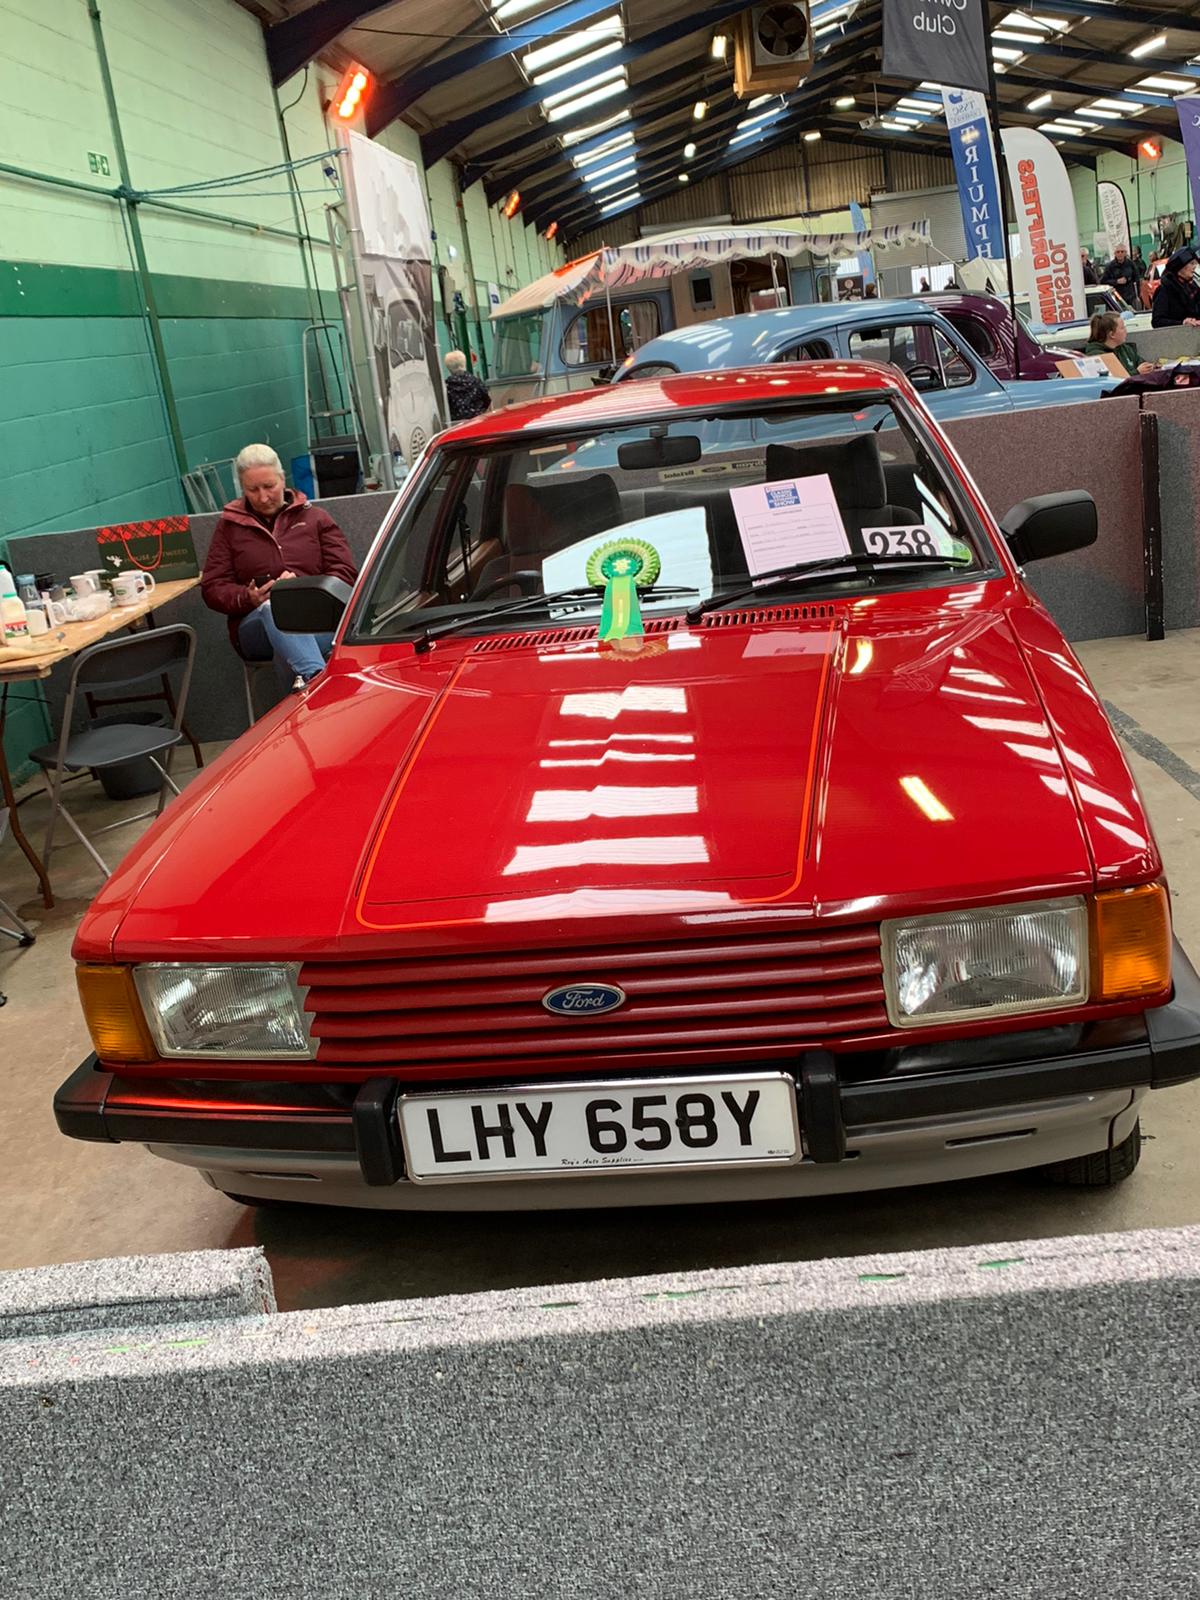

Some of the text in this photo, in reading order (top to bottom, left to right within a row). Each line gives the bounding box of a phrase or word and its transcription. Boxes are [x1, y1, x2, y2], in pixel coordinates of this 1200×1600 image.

[868, 528, 937, 556] 238
[562, 990, 605, 1009] Ford
[425, 1090, 761, 1163] LHY 658Y
[560, 1158, 579, 1166] Roy's
[582, 1157, 600, 1165] Auto
[602, 1156, 632, 1165] Supplies
